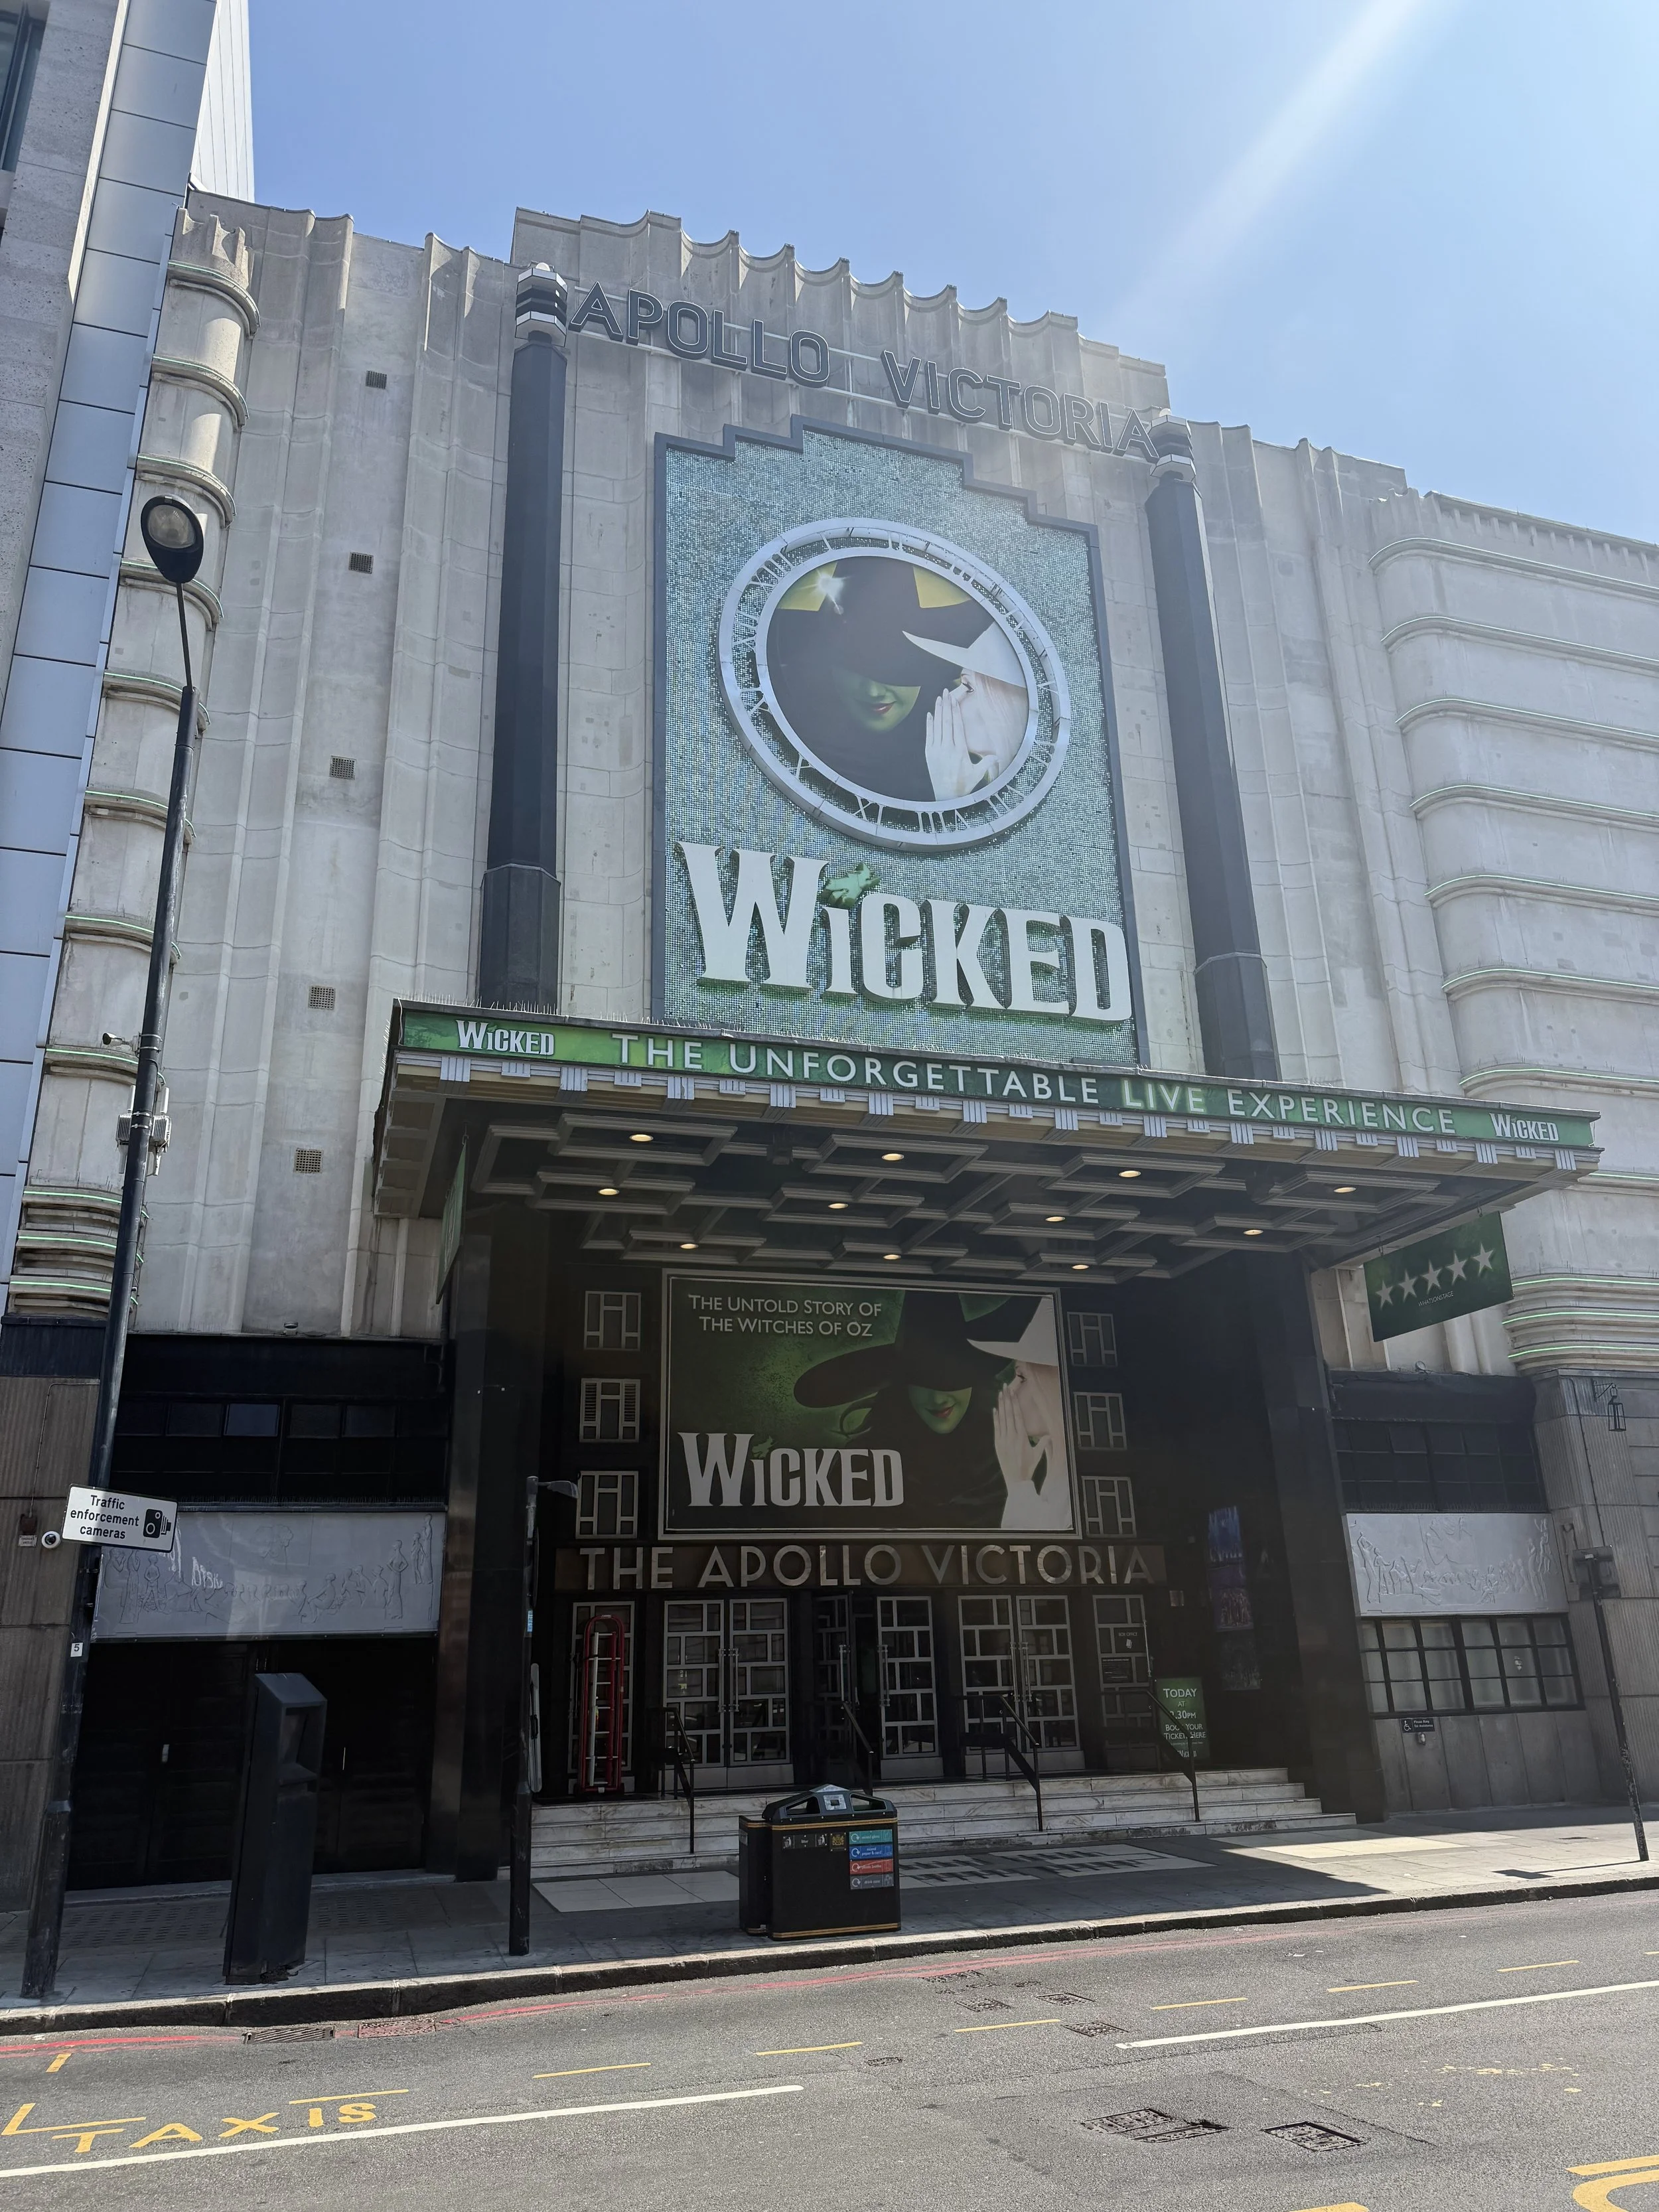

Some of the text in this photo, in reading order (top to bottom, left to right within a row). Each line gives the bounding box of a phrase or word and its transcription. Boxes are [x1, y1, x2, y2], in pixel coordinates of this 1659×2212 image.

[569, 281, 1161, 464] APOLLO VICTORIA
[612, 1033, 1457, 1134] THE UNFORGETTABLE LIVE EXPERIENCE
[688, 1293, 882, 1317] THE UNTOLD STORY OF
[1417, 1290, 1454, 1307] WHATSONSTAGE
[699, 1316, 873, 1337] THE WITCHES OF OZ
[90, 1495, 125, 1510] Traffic
[70, 1509, 139, 1526] enforcement
[80, 1525, 126, 1539] cameras
[579, 1544, 1155, 1589] THE APOLLO VICTORIA
[74, 1643, 80, 1652] 5
[1163, 1688, 1197, 1698] TODAY
[52, 2102, 377, 2153] TAXIS
